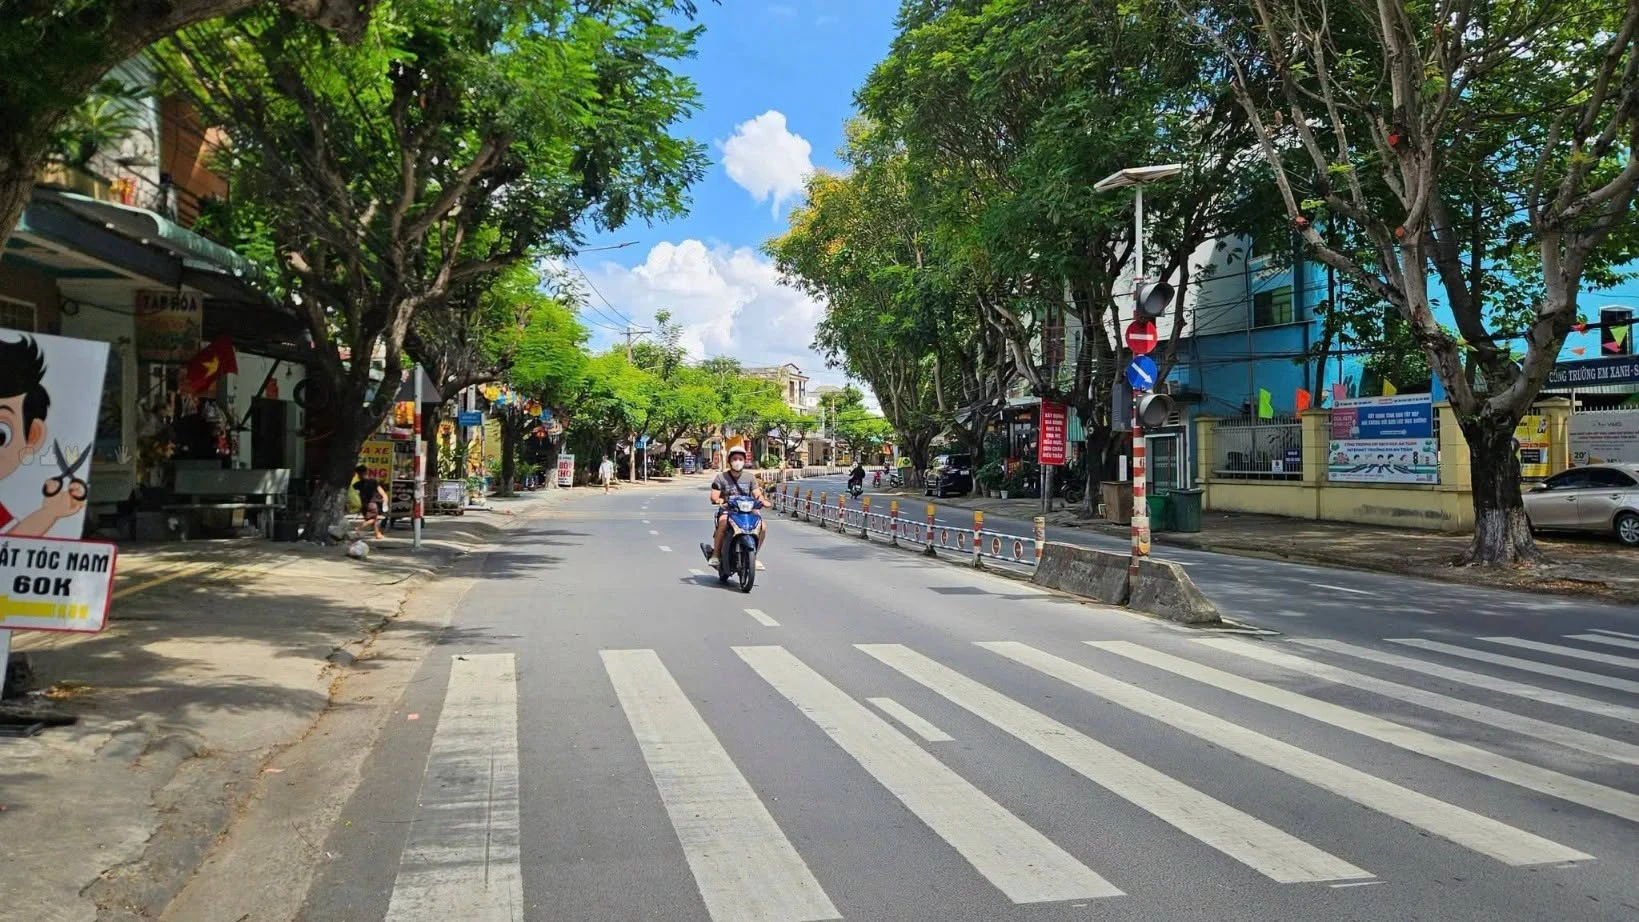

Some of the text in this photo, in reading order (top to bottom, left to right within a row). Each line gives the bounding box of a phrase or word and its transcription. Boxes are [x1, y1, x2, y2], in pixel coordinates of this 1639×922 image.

[1568, 365, 1596, 381] TRƯỜNG
[1597, 366, 1608, 379] EM
[374, 447, 389, 455] XE
[0, 541, 110, 573] ẮT TÓC NAM
[13, 575, 73, 597] 60K
